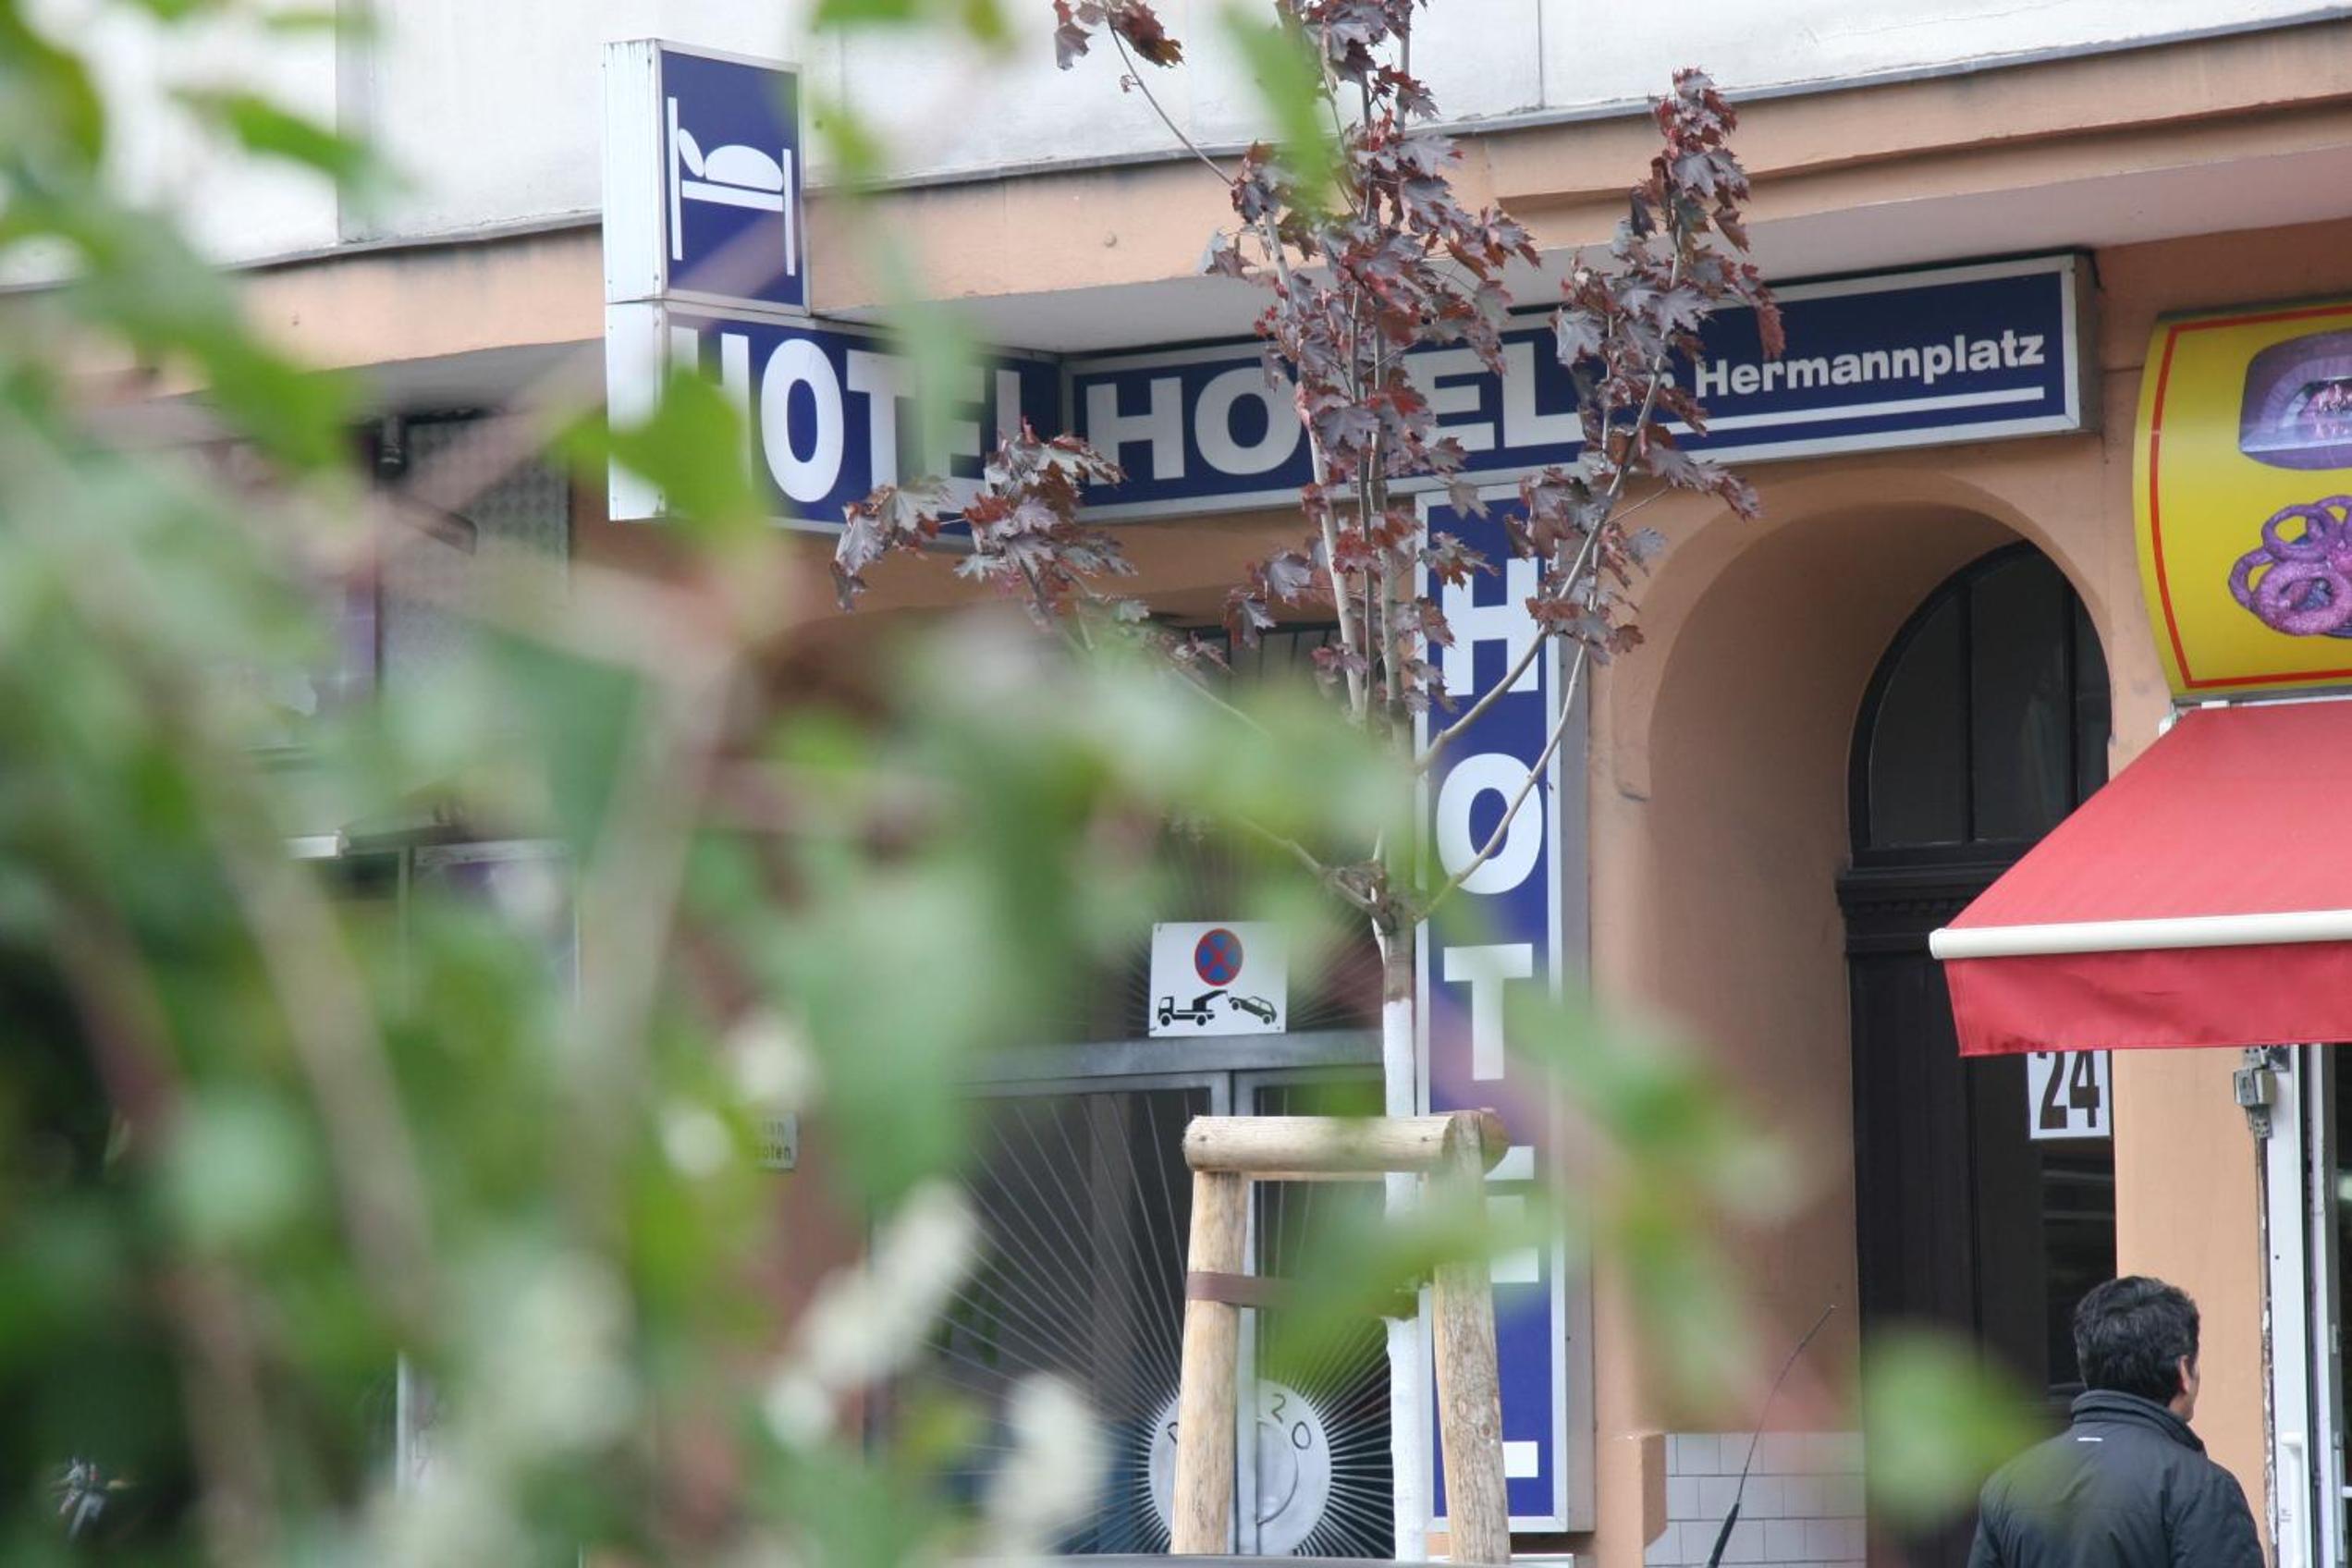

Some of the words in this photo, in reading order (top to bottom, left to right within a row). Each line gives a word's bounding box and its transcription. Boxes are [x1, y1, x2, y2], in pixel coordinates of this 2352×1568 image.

[1085, 340, 1586, 484] HOEL
[1696, 329, 2046, 398] Hermannplatz
[2037, 1049, 2101, 1130] 24
